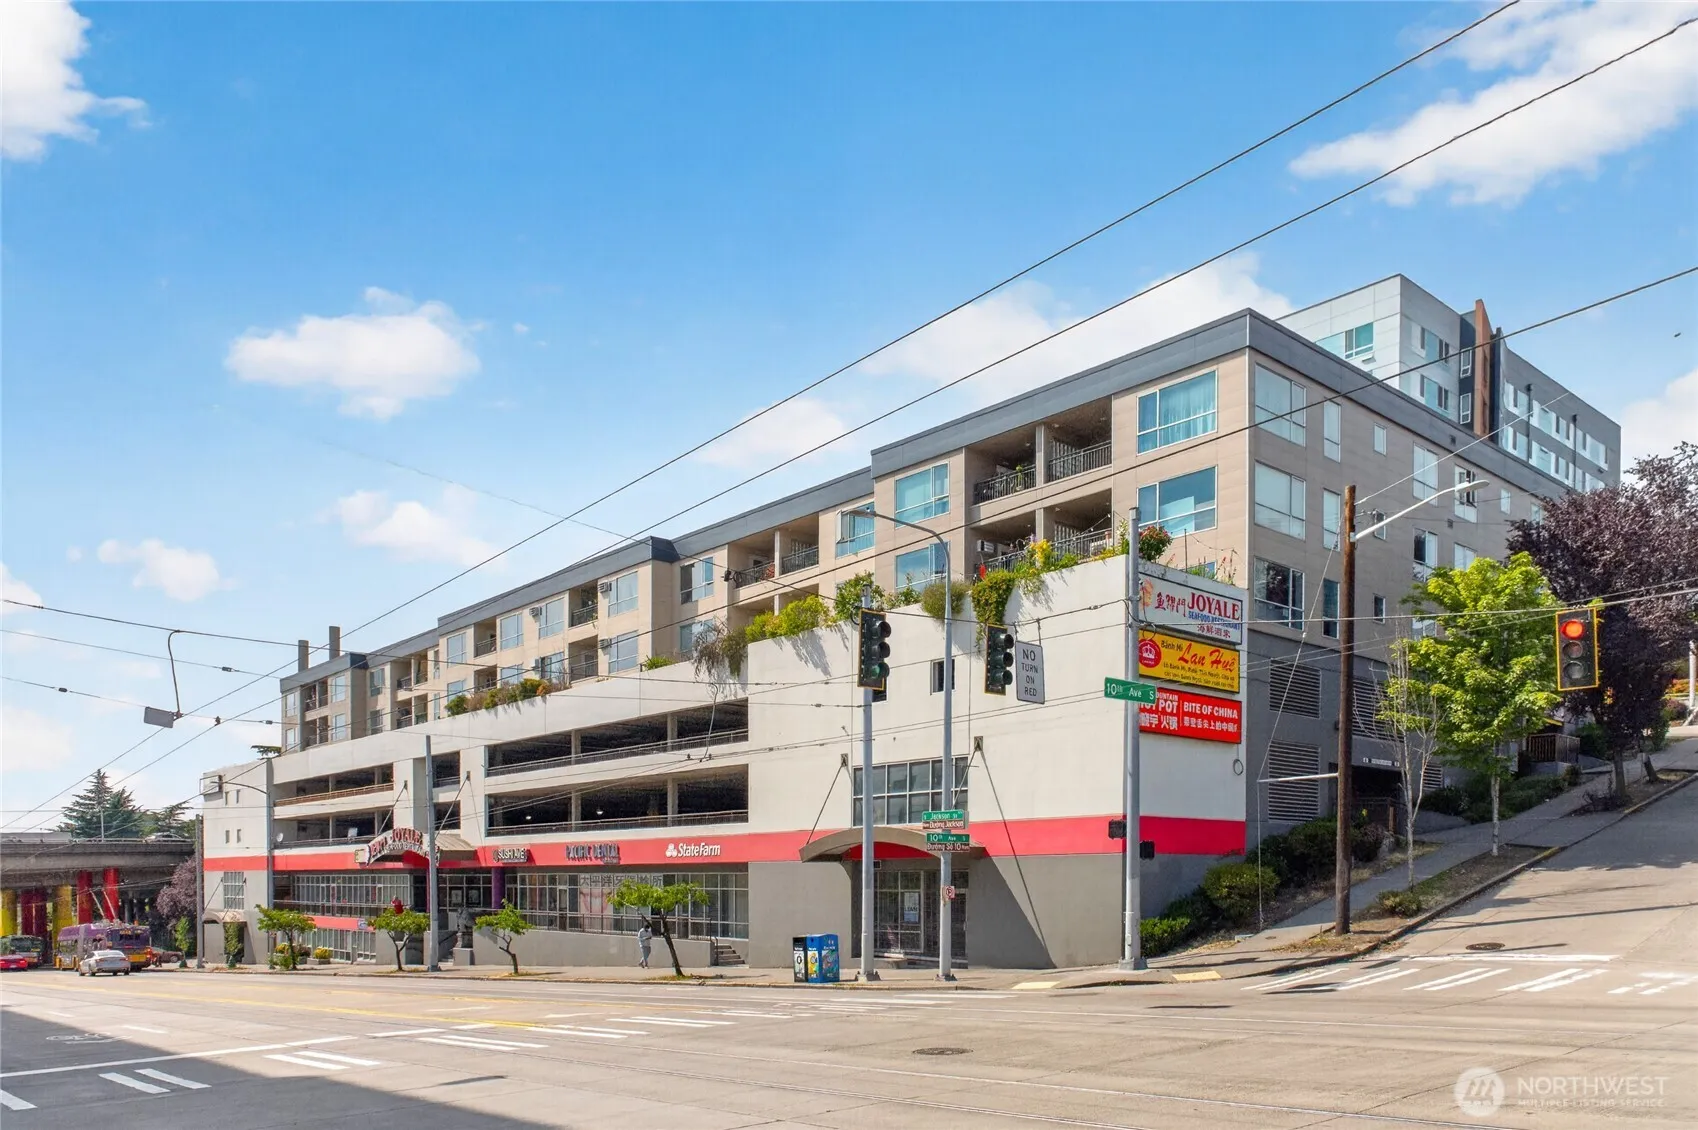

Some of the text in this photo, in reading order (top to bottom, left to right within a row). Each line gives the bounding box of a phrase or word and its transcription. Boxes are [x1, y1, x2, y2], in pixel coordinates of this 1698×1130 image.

[1187, 592, 1240, 620] JOYALE
[1022, 649, 1036, 661] NO
[1178, 642, 1206, 665] Lan
[1021, 662, 1039, 673] TURN
[1025, 675, 1035, 684] ON
[1024, 686, 1037, 697] RED
[1129, 687, 1142, 698] Ave
[1149, 690, 1154, 700] S
[1159, 699, 1179, 713] POT
[1183, 701, 1238, 719] BITE OF CHINA
[930, 812, 951, 820] Jackson
[945, 820, 964, 829] Jackson
[498, 848, 514, 859] SUSHI
[566, 843, 618, 859] PACIFIC DENTAL
